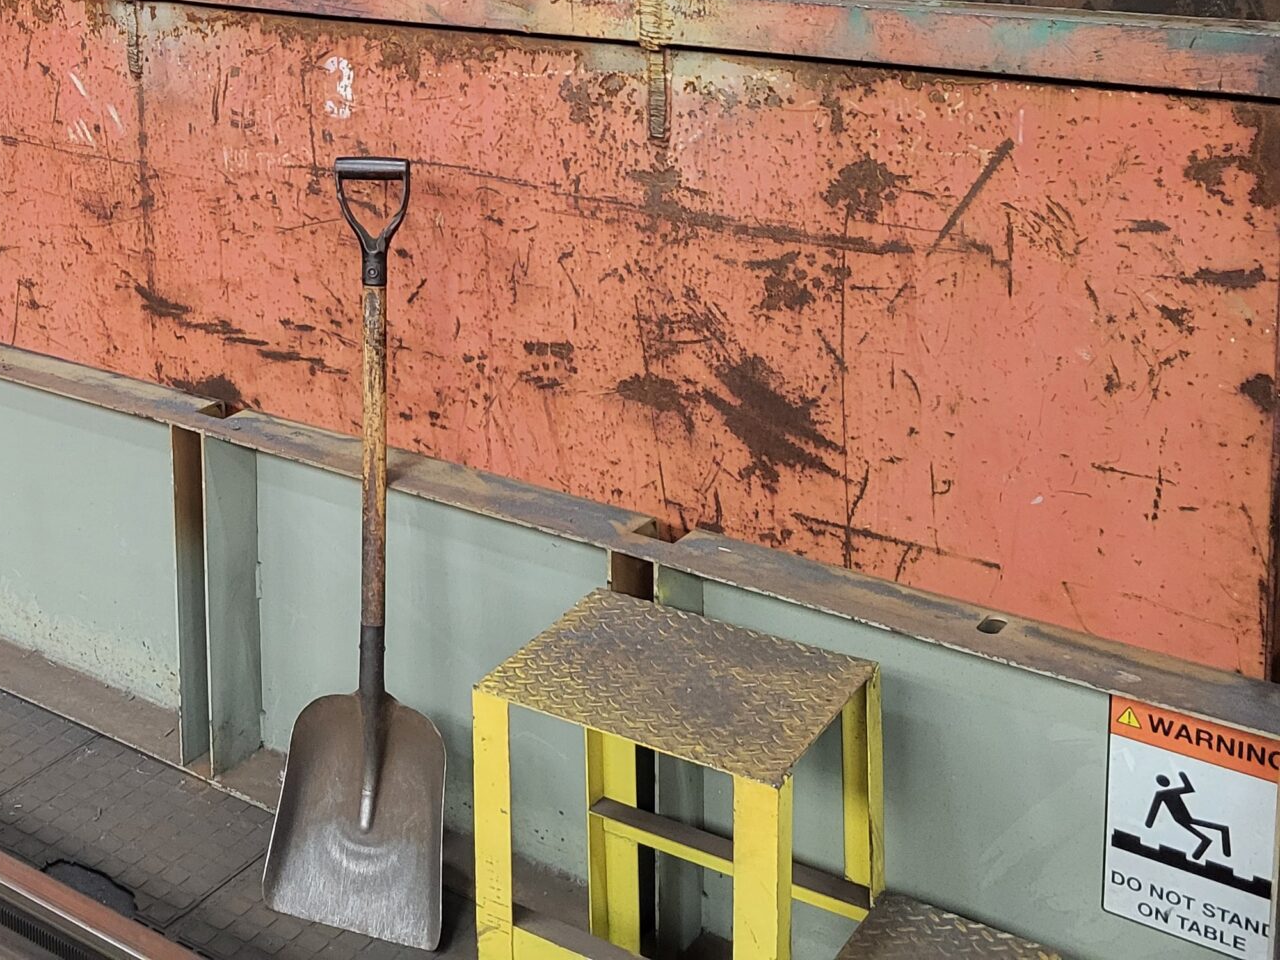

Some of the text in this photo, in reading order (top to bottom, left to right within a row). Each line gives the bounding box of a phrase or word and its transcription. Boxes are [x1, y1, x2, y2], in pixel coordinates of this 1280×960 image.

[1111, 870, 1142, 892] DO
[1150, 883, 1196, 910] NOT
[1137, 902, 1247, 952] ON TABLE
